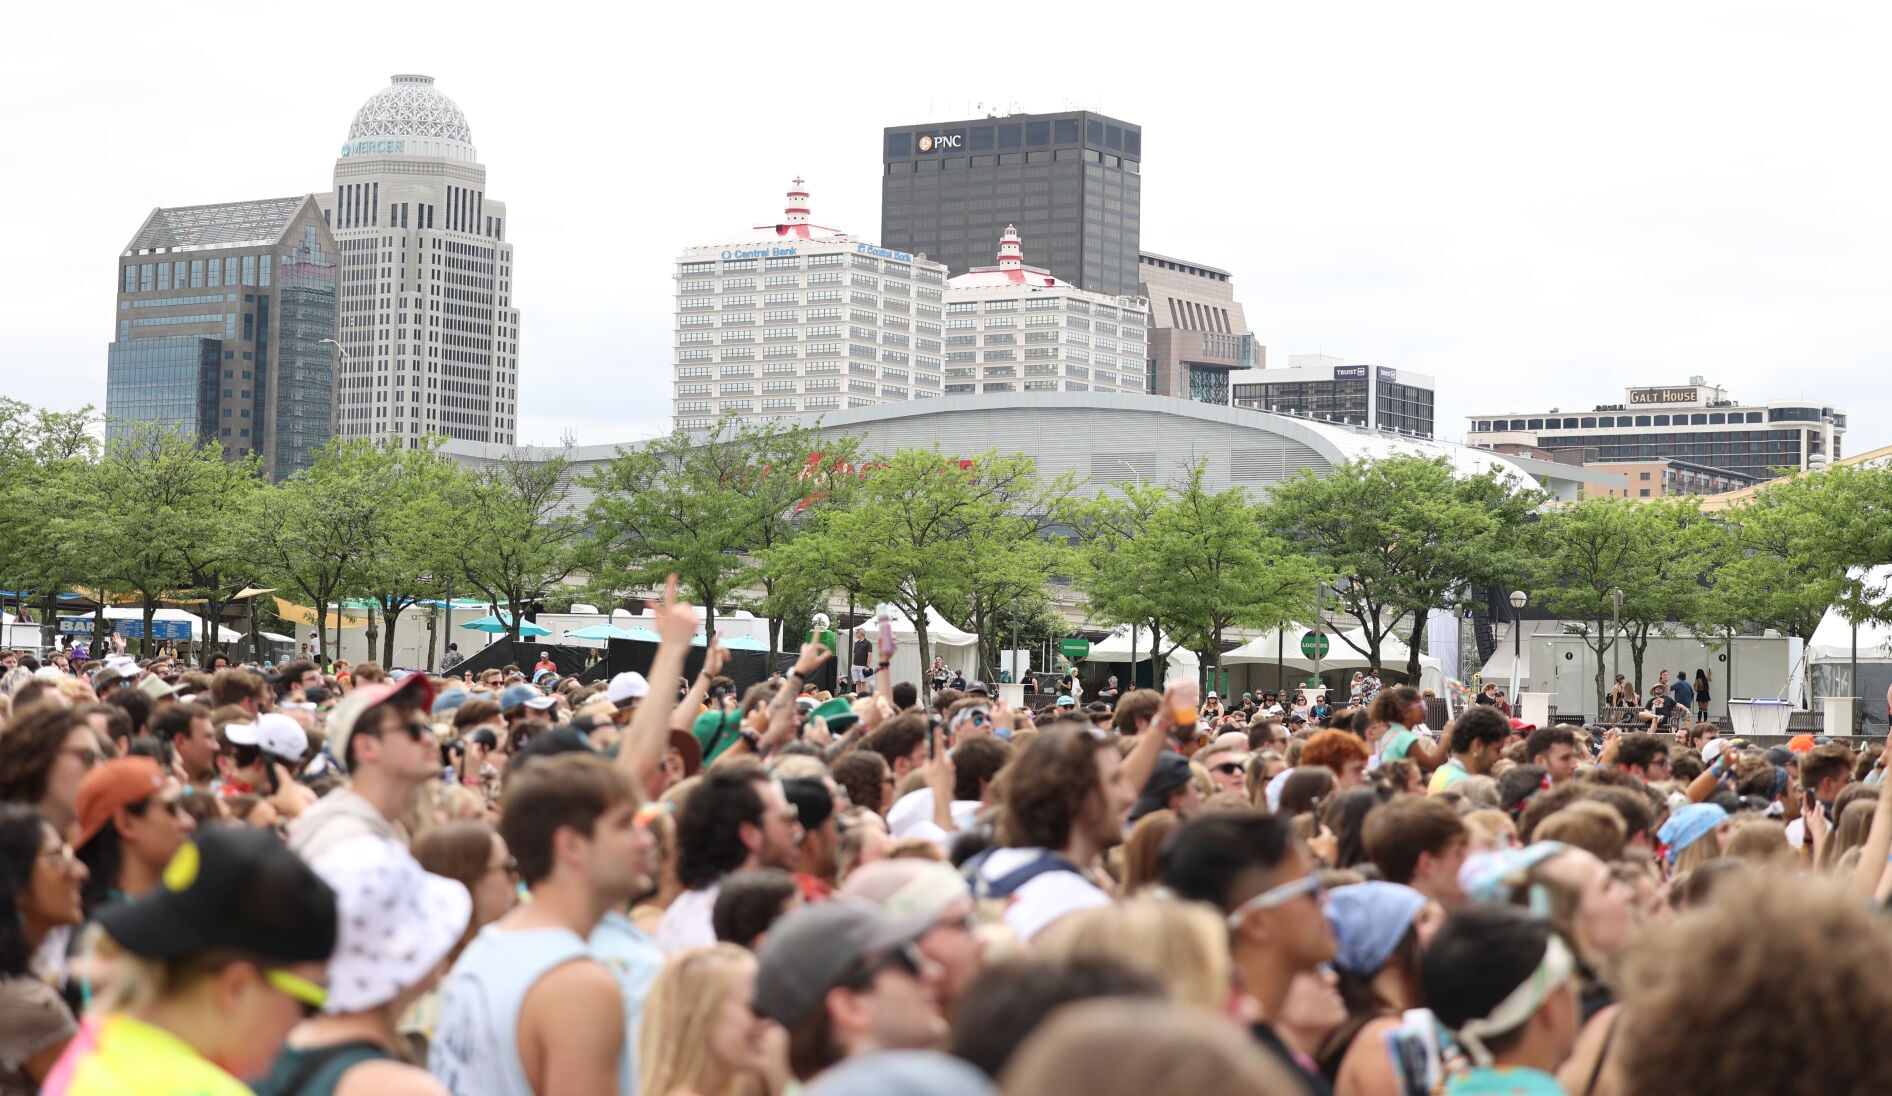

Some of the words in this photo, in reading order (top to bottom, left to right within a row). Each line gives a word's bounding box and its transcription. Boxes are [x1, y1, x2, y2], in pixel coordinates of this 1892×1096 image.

[352, 140, 404, 154] MERCER
[934, 135, 962, 149] PNC
[734, 248, 769, 258] Central
[772, 246, 797, 256] Bank
[1631, 391, 1659, 403] GALT
[1663, 390, 1696, 402] HOUSE
